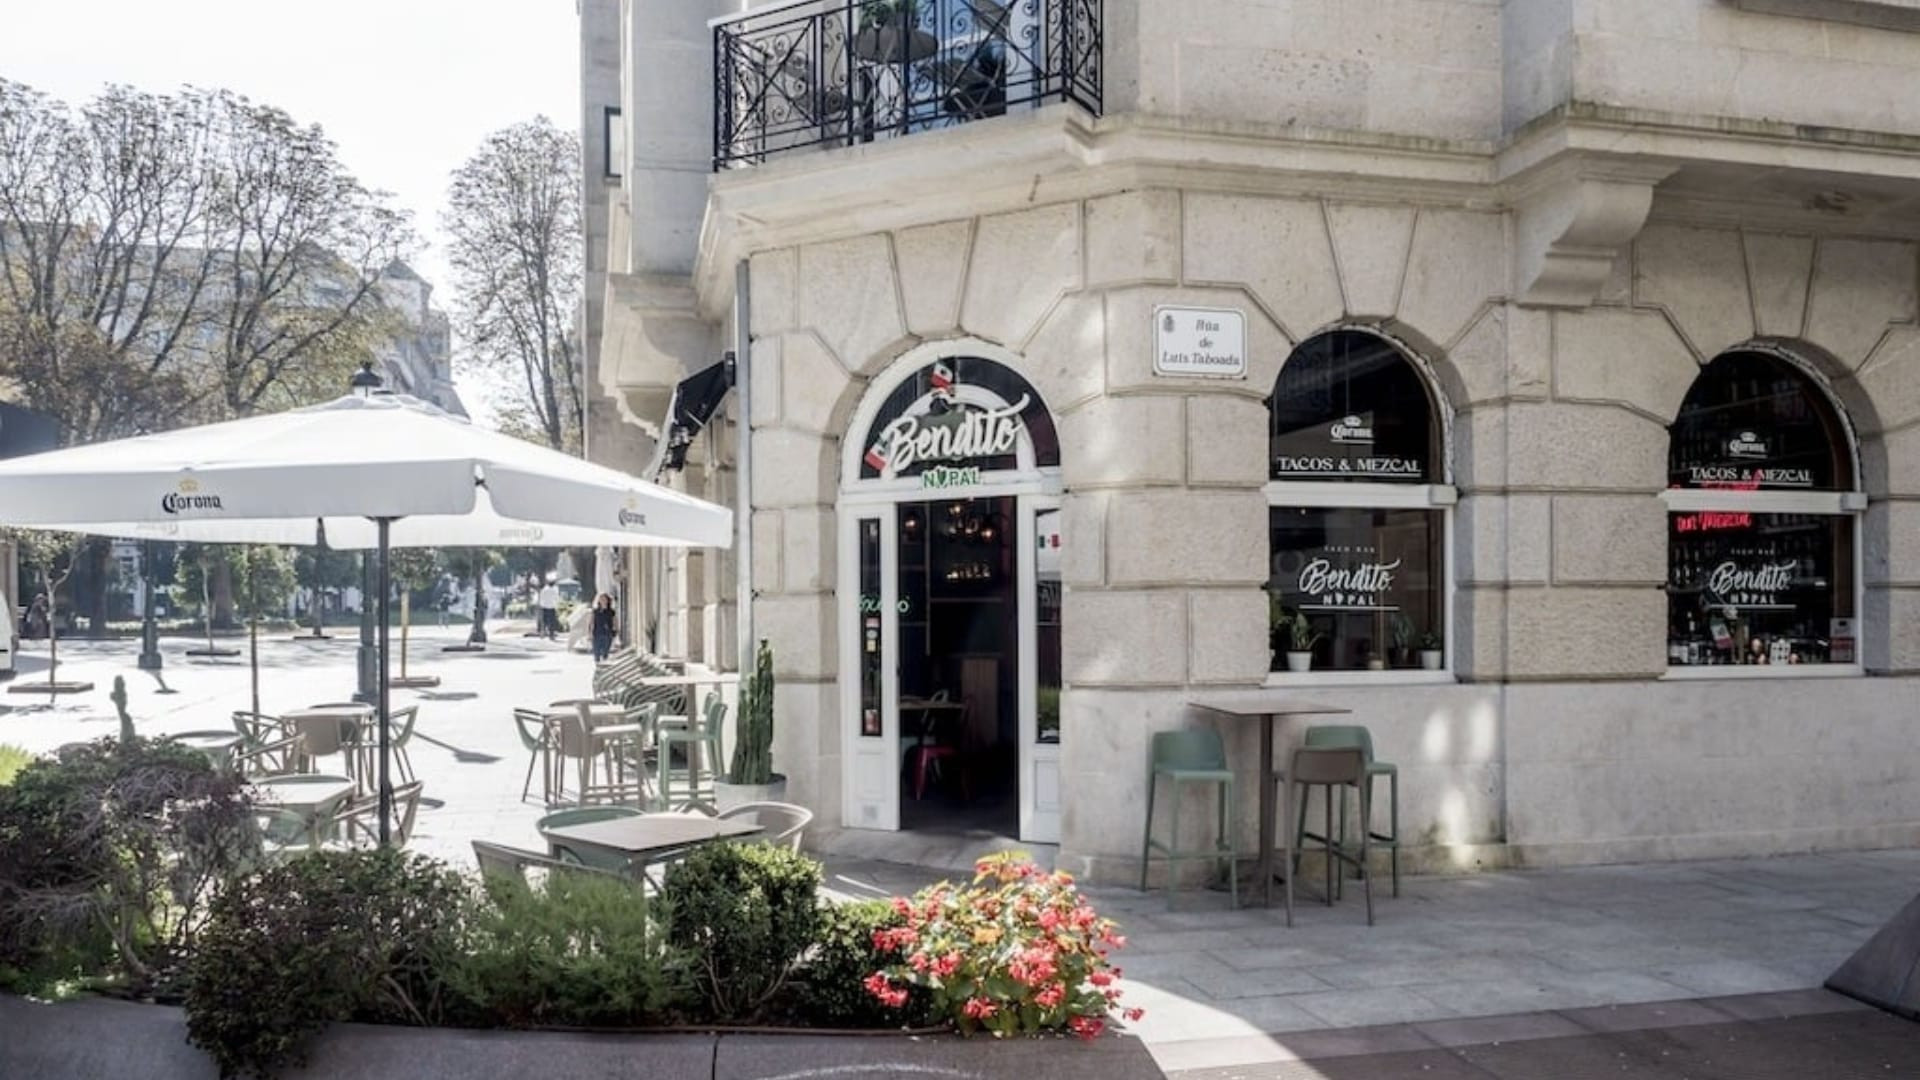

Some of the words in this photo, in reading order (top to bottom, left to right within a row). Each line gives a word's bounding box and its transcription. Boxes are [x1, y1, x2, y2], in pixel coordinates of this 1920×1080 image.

[880, 392, 1031, 472] Bendito
[1330, 424, 1373, 440] Corona
[1277, 457, 1333, 471] TACOS
[1338, 458, 1351, 471] &
[1357, 458, 1421, 473] MEZCAL
[1689, 466, 1738, 480] TACOS
[1741, 468, 1752, 481] &
[1754, 468, 1813, 482] MEZCAL
[162, 492, 224, 514] Corona
[1299, 558, 1400, 594] Bendito
[1709, 559, 1797, 594] Bendito
